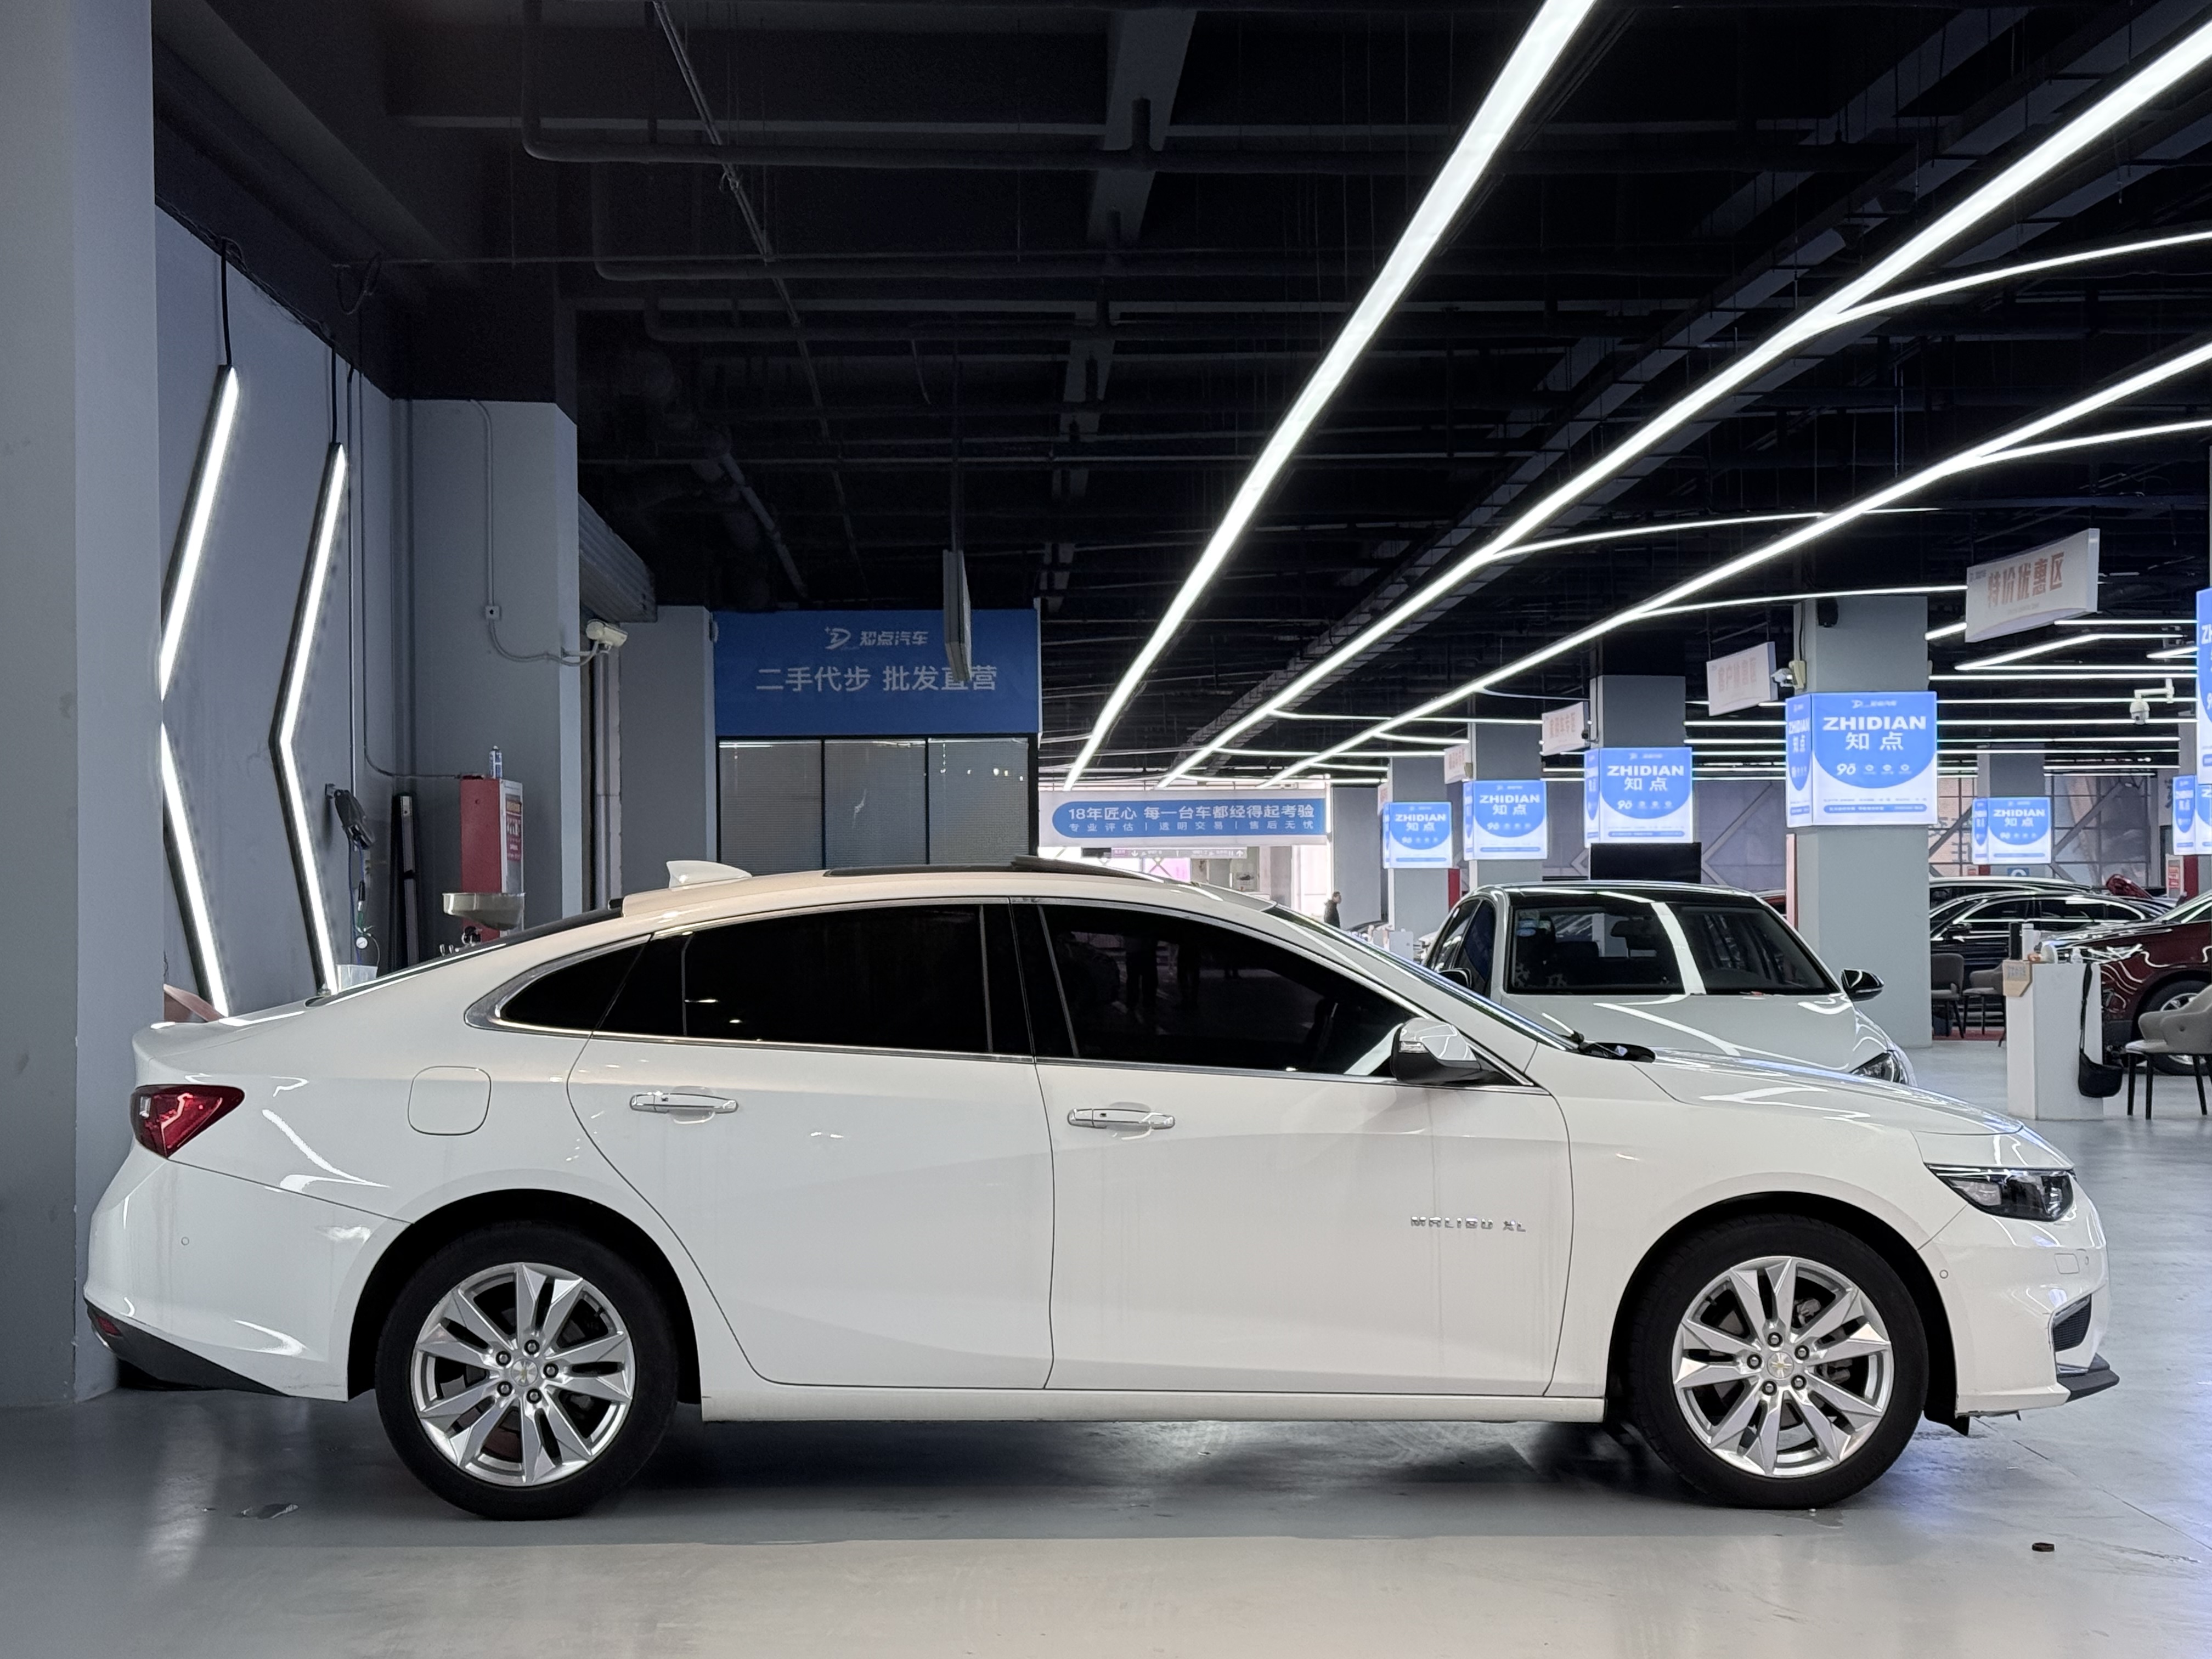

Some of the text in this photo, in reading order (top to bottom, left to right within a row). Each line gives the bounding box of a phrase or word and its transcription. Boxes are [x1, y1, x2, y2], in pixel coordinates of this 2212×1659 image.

[1988, 551, 2064, 609] 特价优惠区
[860, 630, 929, 646] 知点汽车
[756, 664, 997, 692] 二手代步 批发直营
[1822, 715, 1927, 731] ZHIDIAN
[1845, 731, 1904, 751] 知点
[1606, 765, 1685, 776] ZHIDIAN
[1624, 776, 1668, 792] 知点
[1479, 794, 1541, 804] ZHIDIAN
[1069, 804, 1315, 821] 18年匠心 每一台车都经得起考验
[1492, 804, 1527, 816] 知点
[1993, 808, 2046, 817] ZHIDIAN
[1395, 813, 1447, 822] ZHIDIAN
[2004, 817, 2034, 827] 知点
[1069, 820, 1314, 832] 专业评估 透明交易 售后无忧
[1406, 821, 1436, 832] 知点
[1410, 1216, 1527, 1232] MALIBU XL
